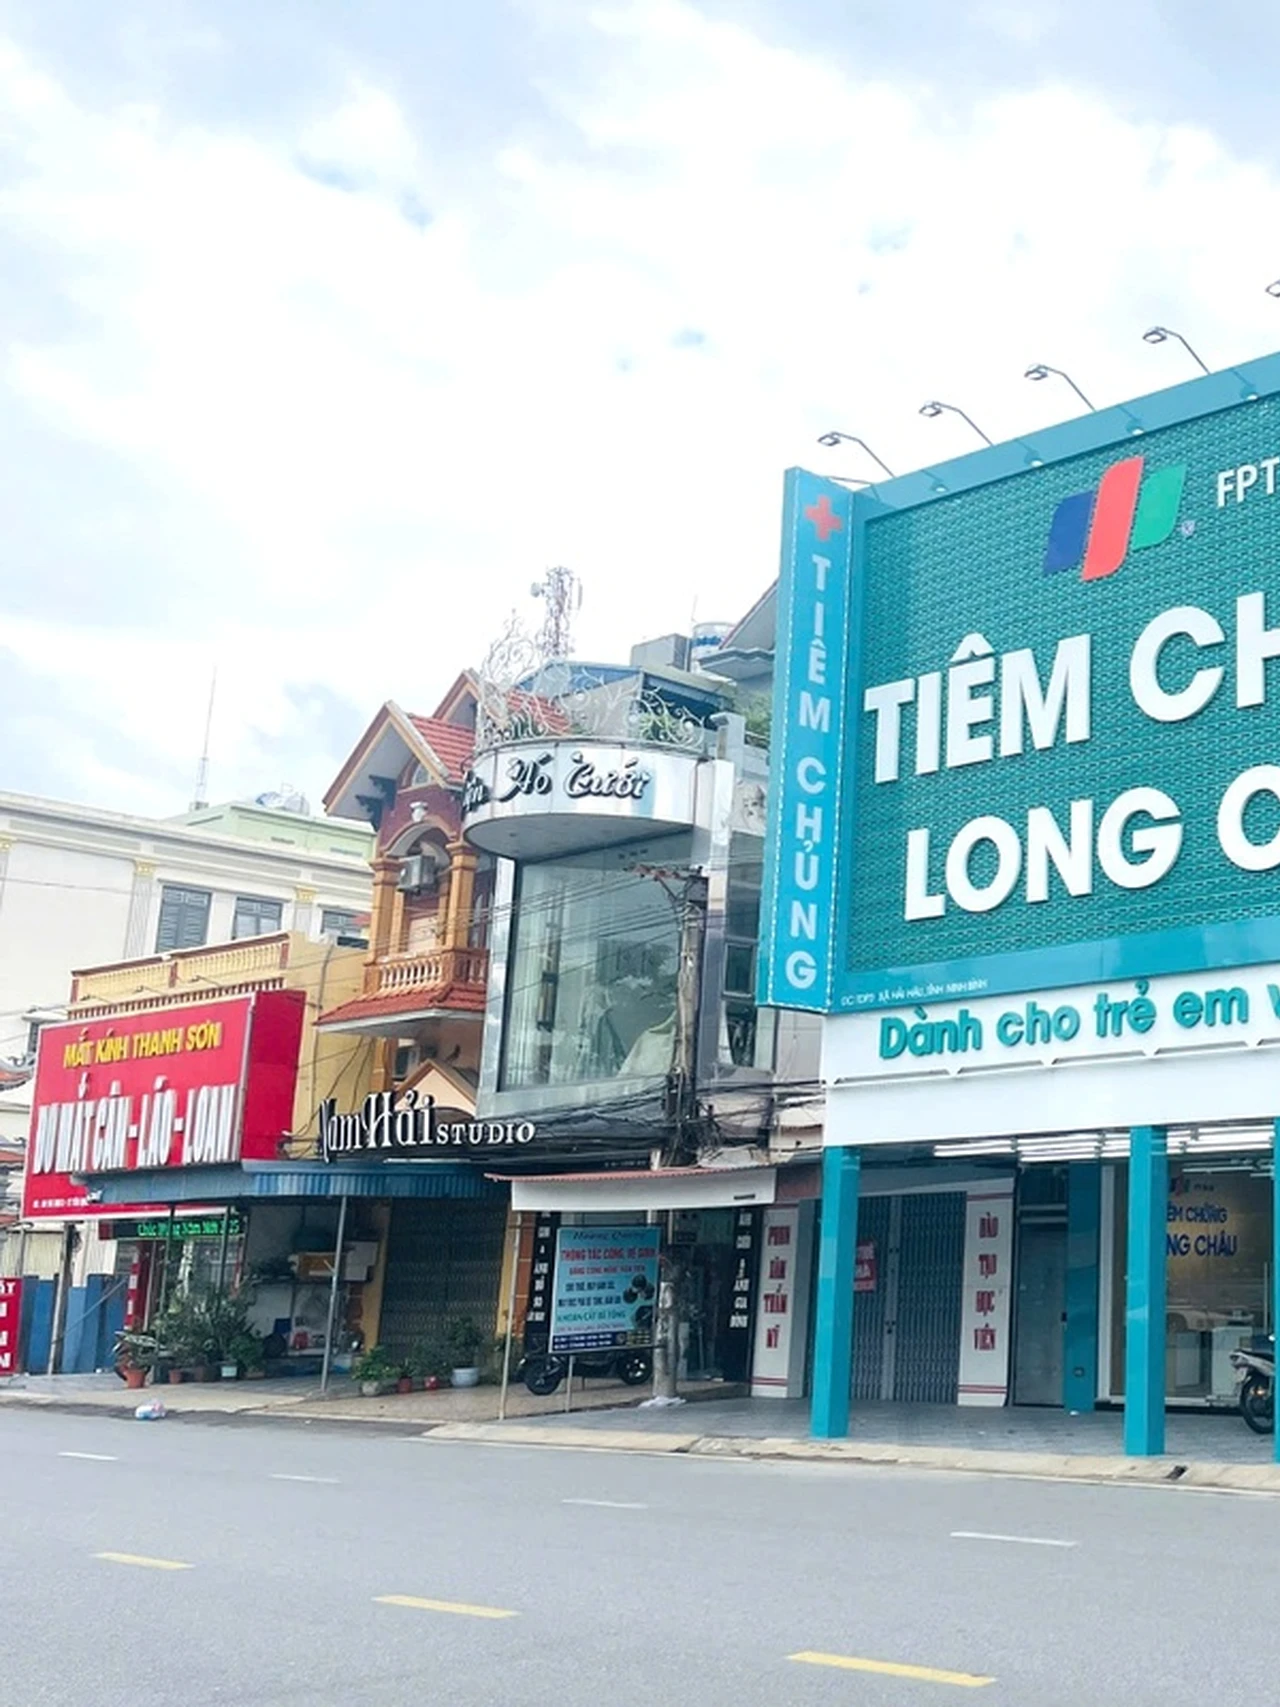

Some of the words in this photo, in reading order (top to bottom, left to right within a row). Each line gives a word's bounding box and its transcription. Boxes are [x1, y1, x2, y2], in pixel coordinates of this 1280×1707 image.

[1216, 457, 1280, 507] FPT
[800, 554, 831, 734] TIÊM
[864, 632, 1092, 784] TIÊM
[785, 757, 827, 989] CHỦNG
[904, 787, 1183, 922] LONG
[132, 1027, 184, 1058] THANH
[186, 1019, 223, 1051] SƠN
[879, 1005, 983, 1060] Dành
[997, 1001, 1082, 1047] cho
[1094, 979, 1157, 1038] trẻ
[1173, 985, 1250, 1029] em
[361, 1090, 435, 1149] Hải
[436, 1122, 535, 1144] STUDIO
